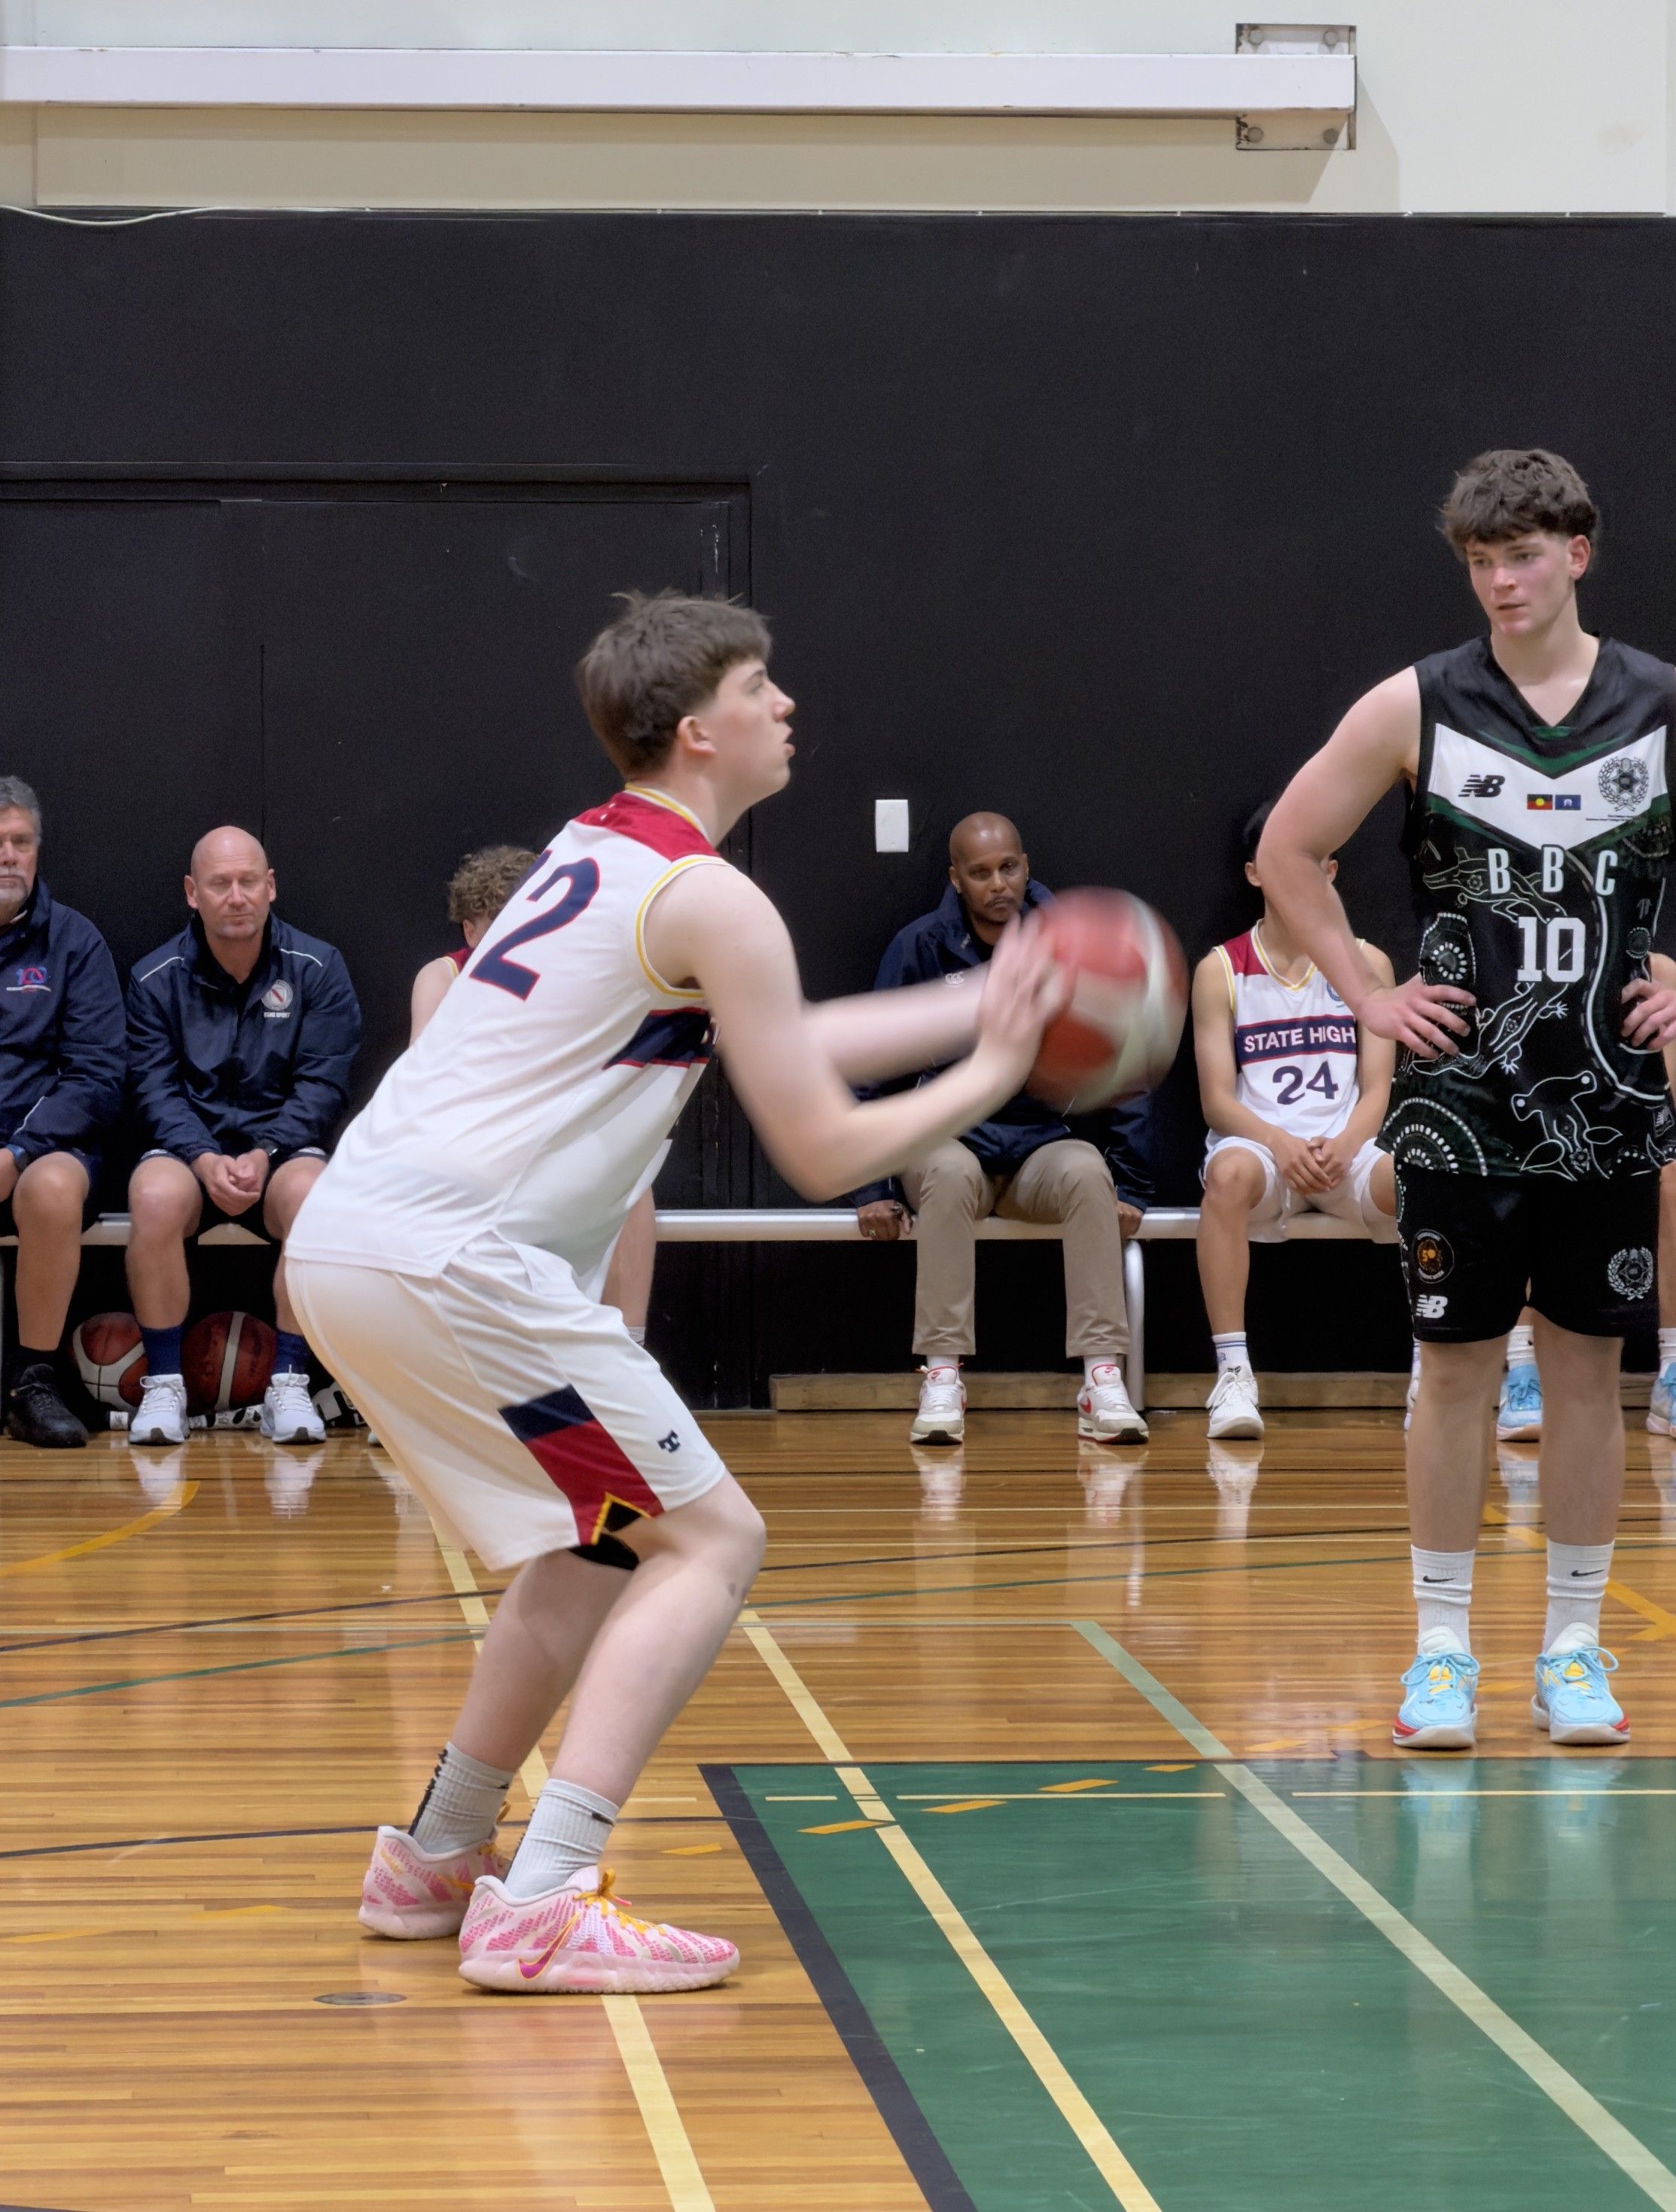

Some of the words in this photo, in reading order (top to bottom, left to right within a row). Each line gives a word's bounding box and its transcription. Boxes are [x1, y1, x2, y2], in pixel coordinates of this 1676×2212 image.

[1517, 916, 1586, 983] 10
[1244, 1028, 1304, 1053] STATE
[1309, 1025, 1356, 1044] HIGH
[1272, 1060, 1339, 1104] 24
